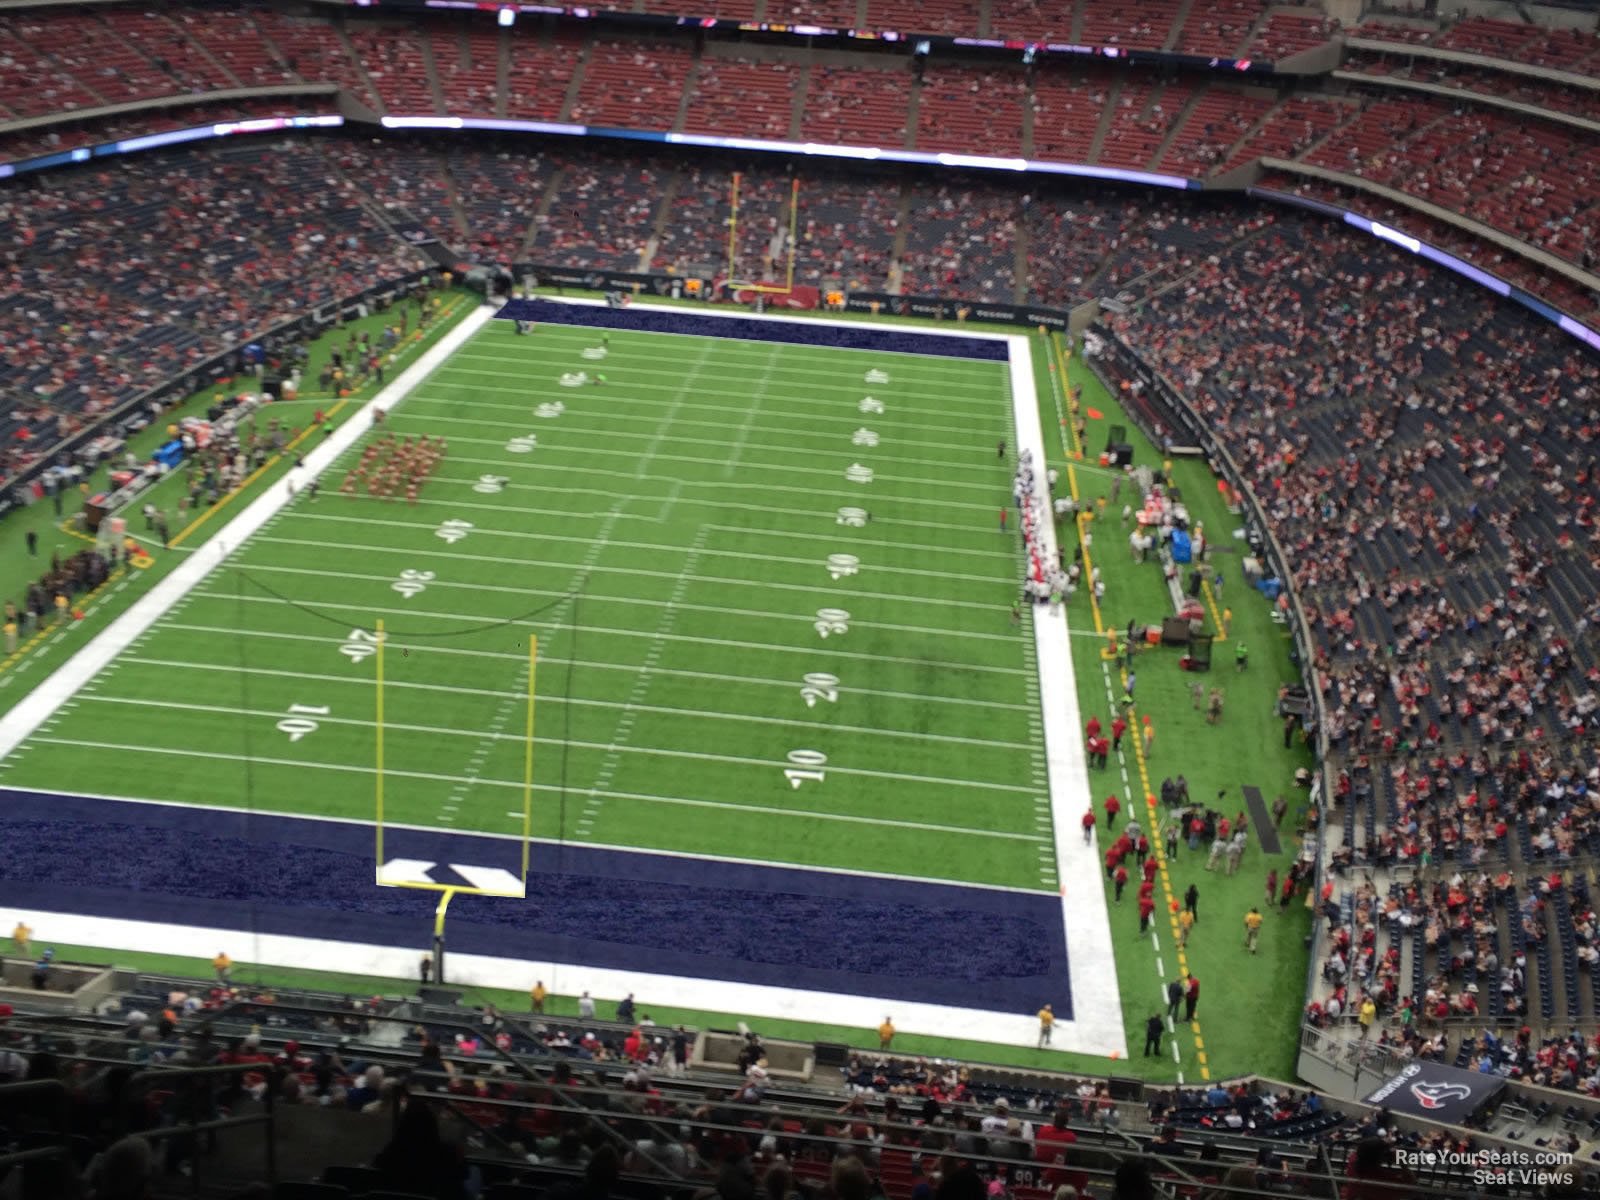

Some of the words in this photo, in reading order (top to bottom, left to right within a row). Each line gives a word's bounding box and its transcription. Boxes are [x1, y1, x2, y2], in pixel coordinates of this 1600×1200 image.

[391, 569, 436, 593] 30
[814, 608, 851, 634] 30
[339, 629, 388, 657] 20
[801, 673, 840, 702] 20
[276, 704, 331, 734] 10
[784, 750, 828, 783] 10
